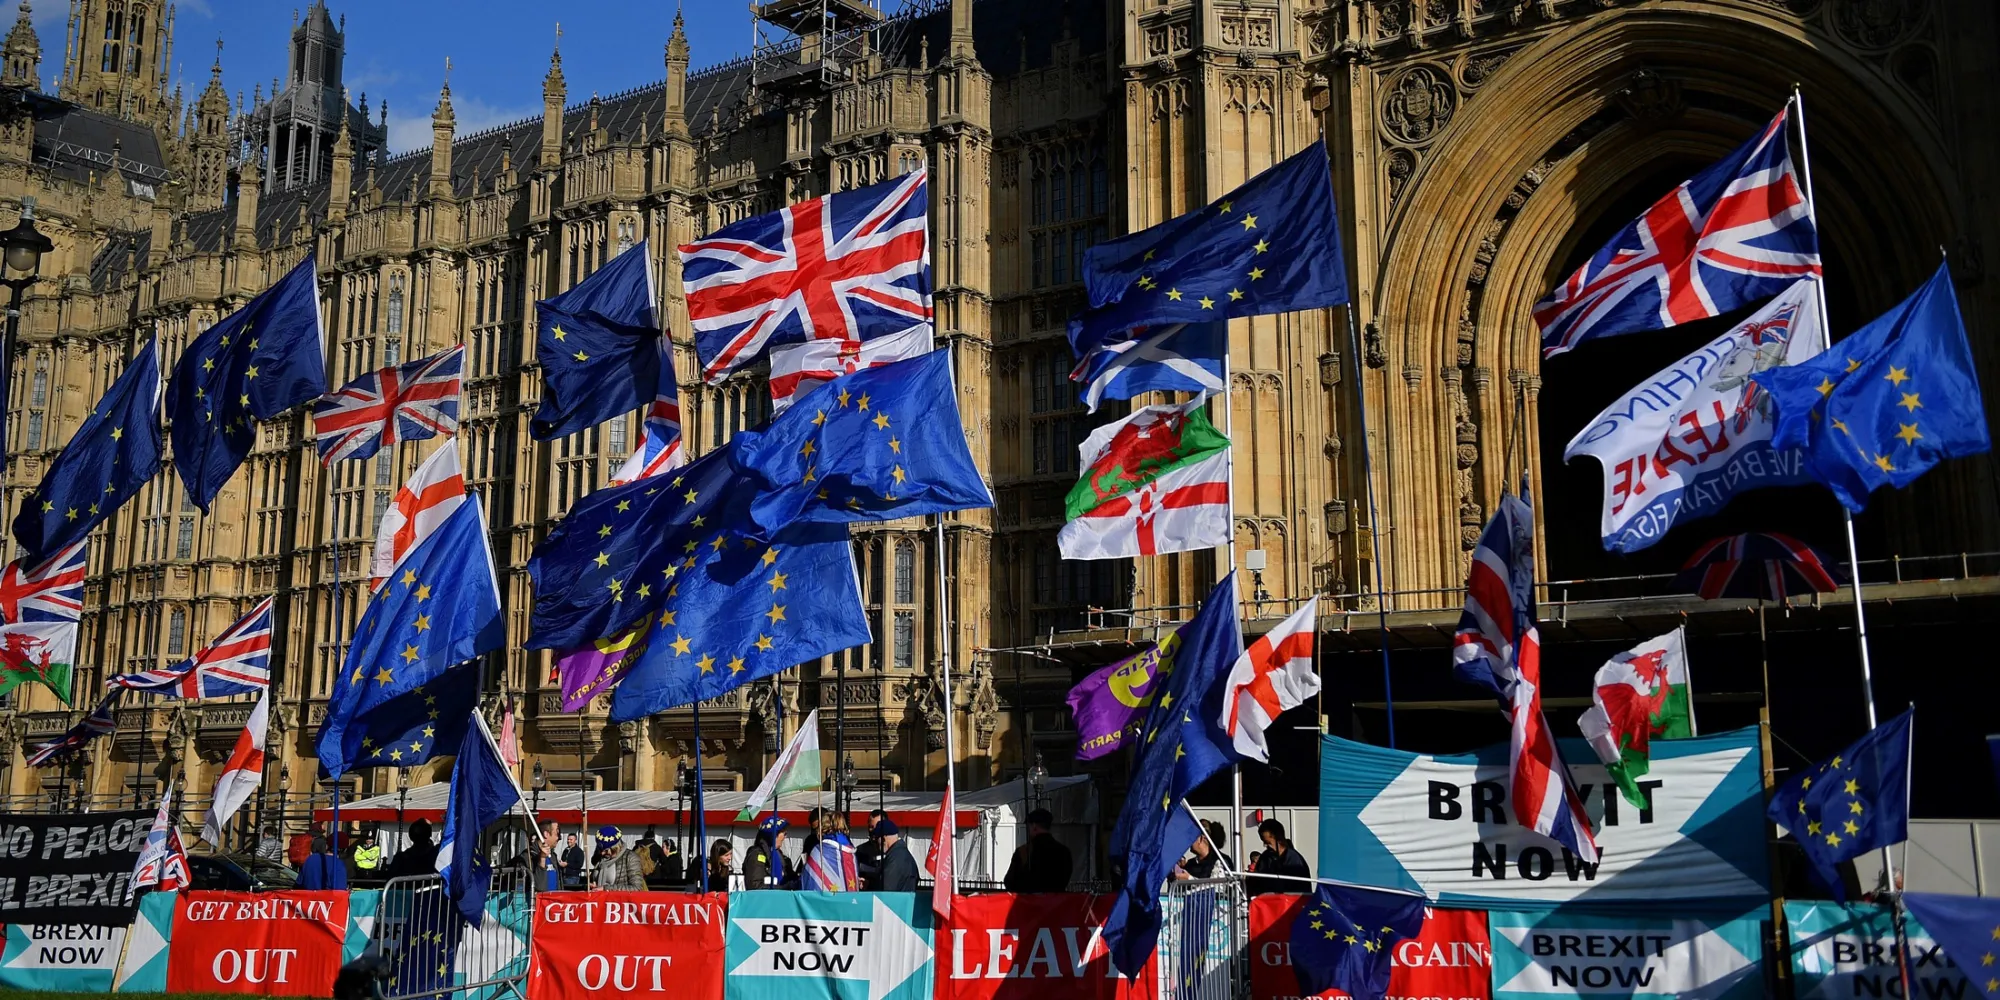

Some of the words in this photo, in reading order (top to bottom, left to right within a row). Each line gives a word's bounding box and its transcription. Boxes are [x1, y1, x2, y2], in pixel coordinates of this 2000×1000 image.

[1428, 780, 1663, 827] BRIT
[0, 824, 34, 859] NO
[42, 818, 155, 860] PEACE
[1472, 841, 1604, 881] NOW
[187, 900, 233, 922] GET
[235, 898, 334, 922] BRITAIN
[545, 902, 598, 924] GET
[604, 902, 711, 925] BRITAIN
[32, 924, 113, 940] BREXIT
[761, 925, 870, 946] BREXIT
[39, 947, 104, 964] NOW
[1391, 942, 1484, 968] GAIN
[1533, 934, 1671, 957] BREXIT
[212, 949, 297, 984] OUT
[577, 954, 671, 991] OUT
[773, 952, 854, 973] NOW
[1551, 965, 1655, 988] NOW
[1853, 973, 1968, 1000] NOW
